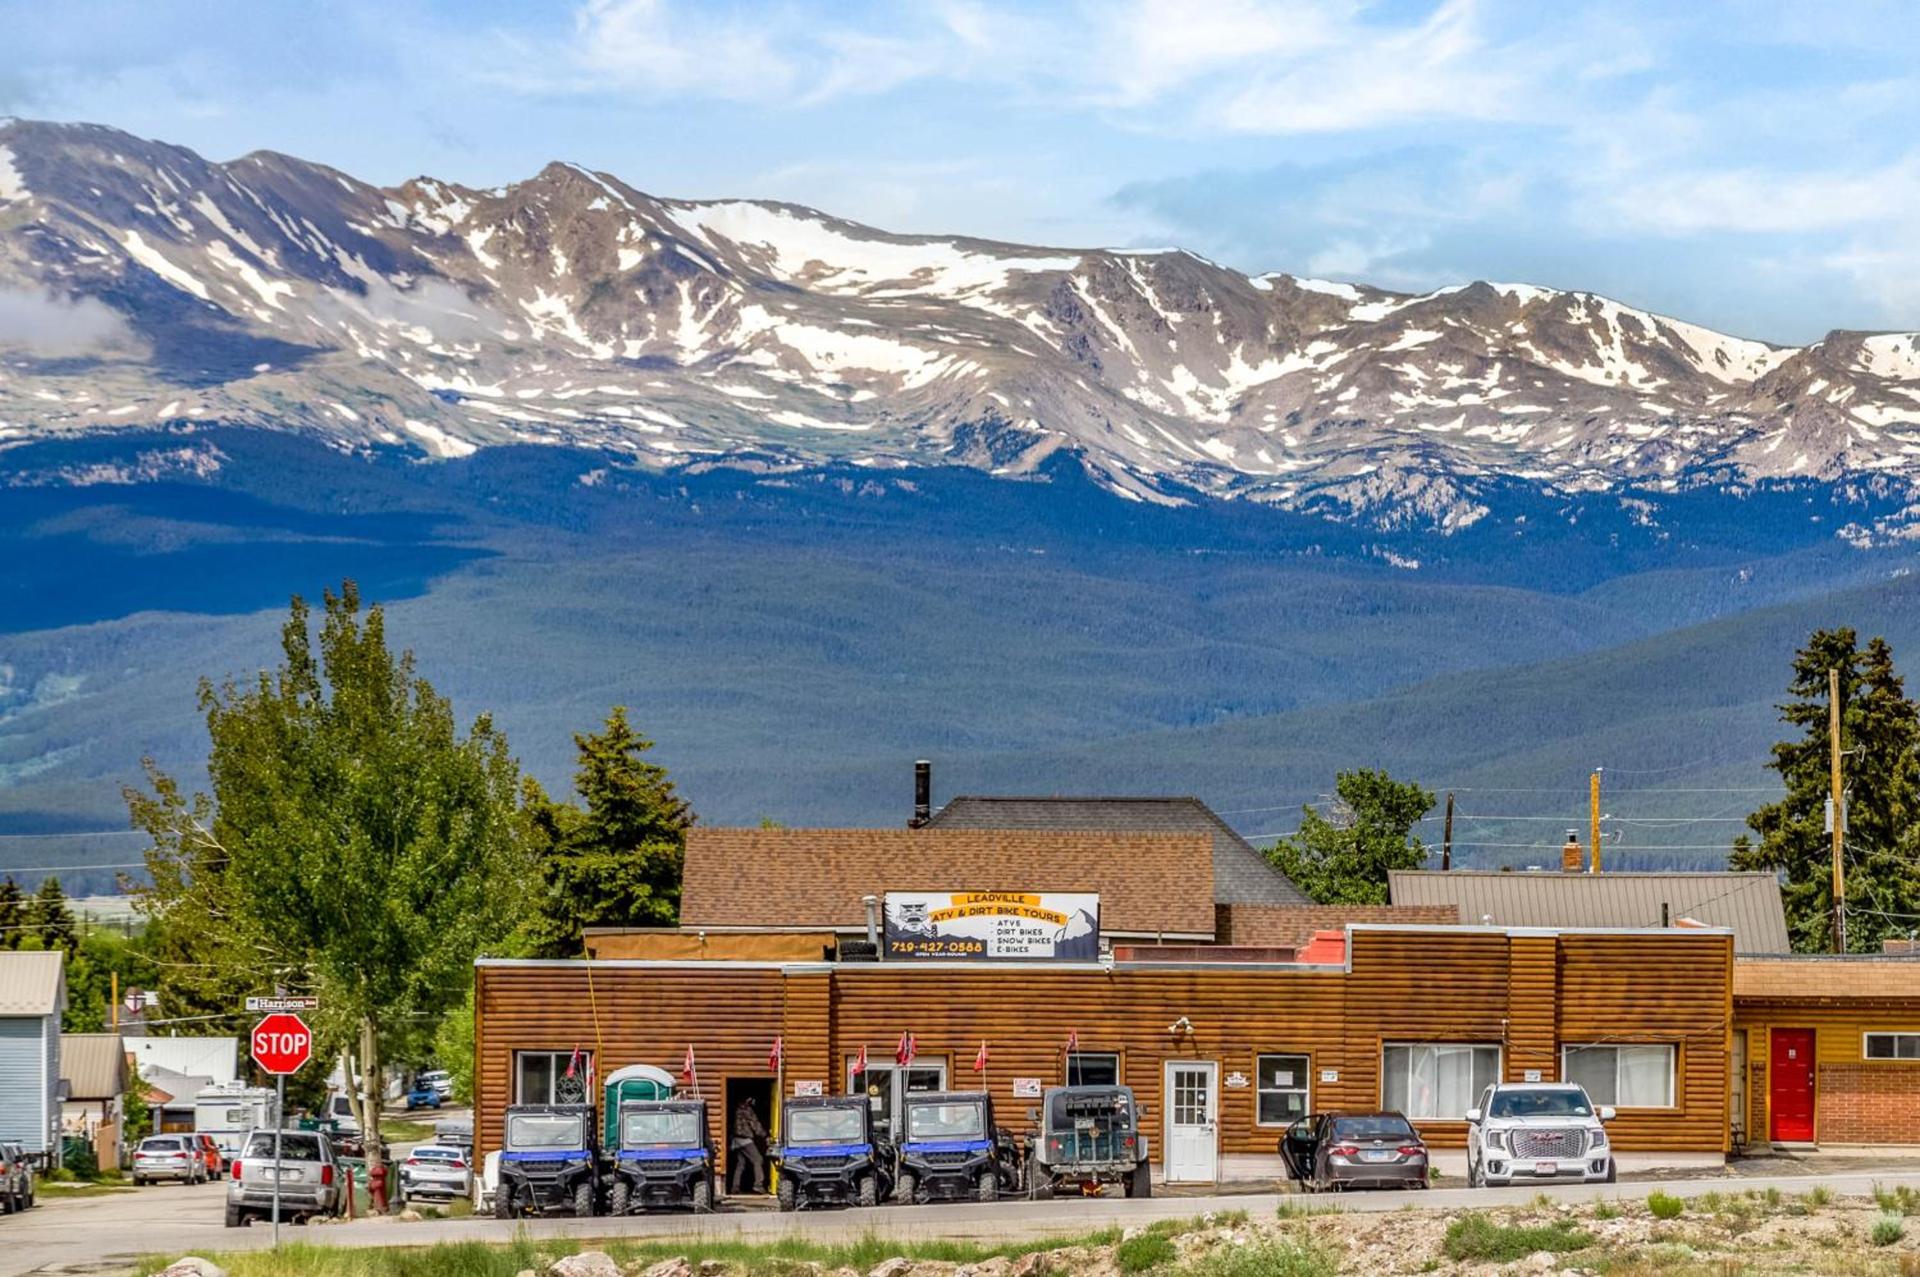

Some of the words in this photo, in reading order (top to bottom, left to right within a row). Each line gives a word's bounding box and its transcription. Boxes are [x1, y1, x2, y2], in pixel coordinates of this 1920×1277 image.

[967, 894, 1025, 904] LEADVILLE
[931, 911, 954, 923] ATV
[958, 908, 966, 918] &
[969, 906, 993, 916] DIRT
[997, 906, 1020, 916] BIKE
[1023, 908, 1060, 924] TOURS
[996, 928, 1016, 936] DIRT
[1019, 928, 1043, 936] BIKES
[997, 937, 1024, 945] SNOW
[1027, 937, 1051, 945] BIKES
[259, 999, 305, 1008] Harrison
[256, 1033, 307, 1055] STOP
